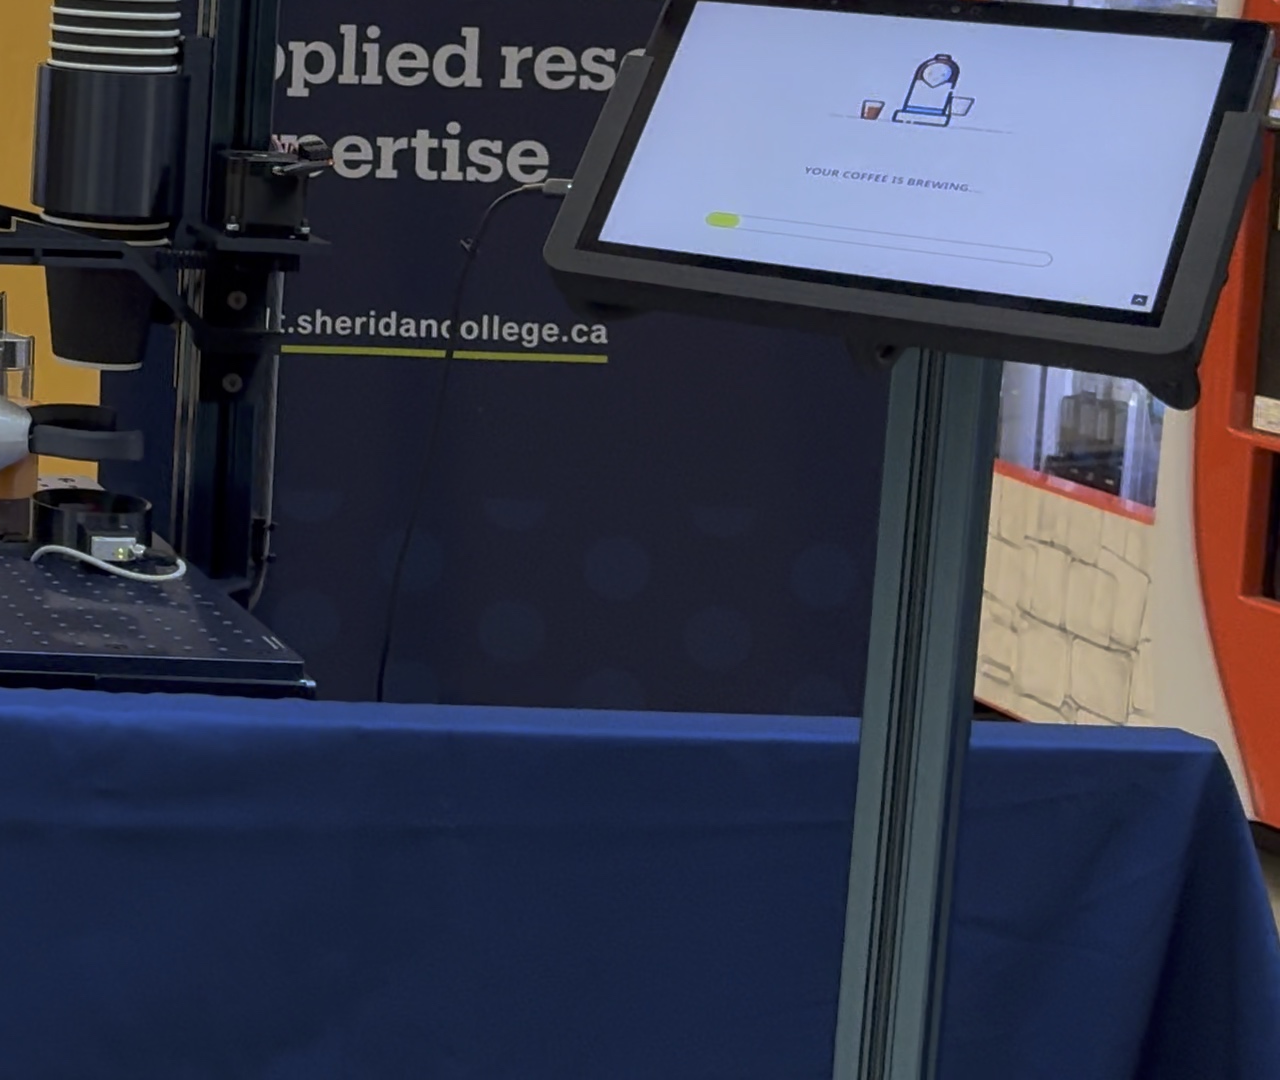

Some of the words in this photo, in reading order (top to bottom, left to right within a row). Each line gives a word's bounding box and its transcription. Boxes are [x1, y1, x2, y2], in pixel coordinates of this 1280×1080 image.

[275, 23, 483, 98] plied
[499, 44, 648, 92] res
[805, 166, 840, 178] YOUR
[842, 170, 889, 184] COFFEE
[891, 176, 904, 185] IS
